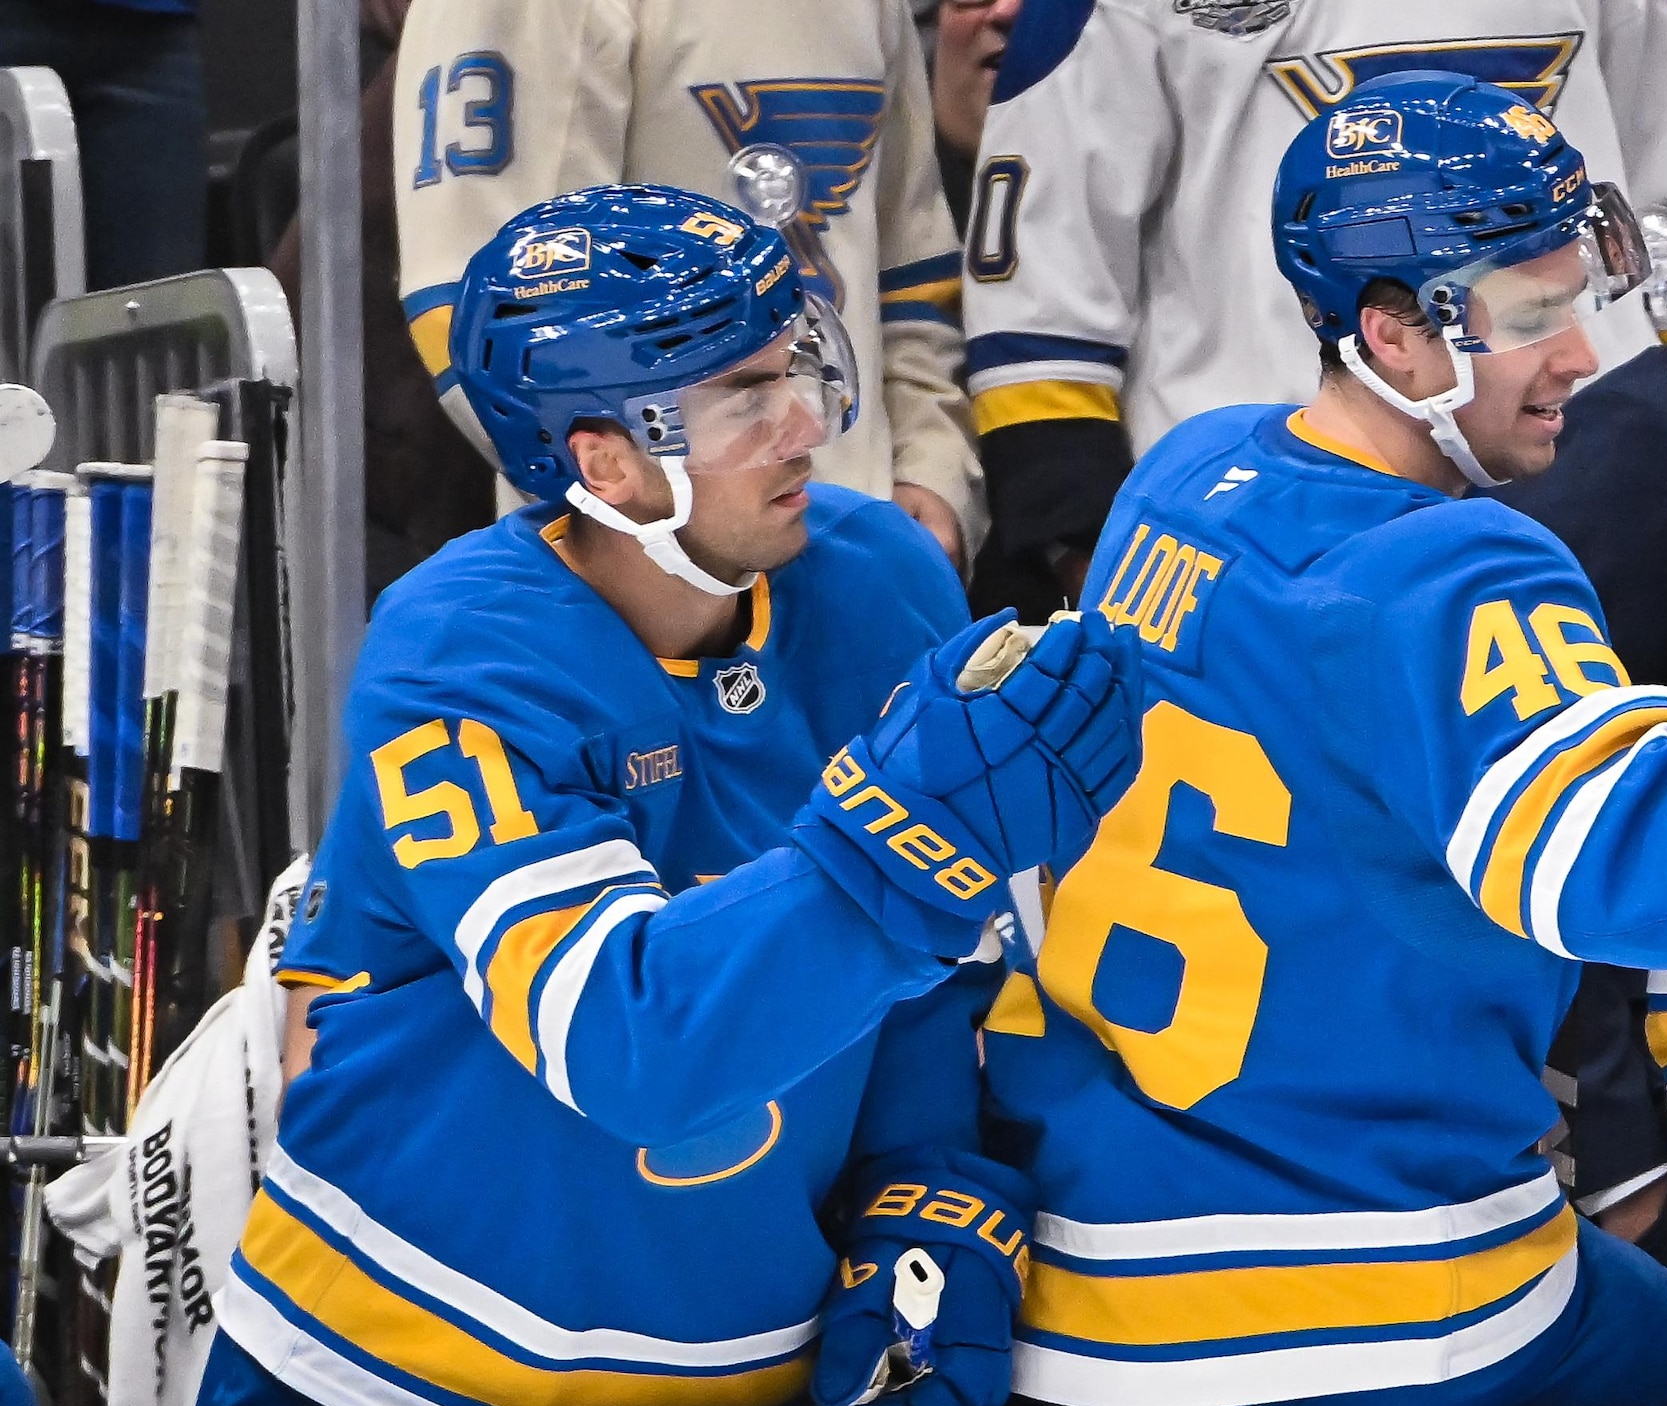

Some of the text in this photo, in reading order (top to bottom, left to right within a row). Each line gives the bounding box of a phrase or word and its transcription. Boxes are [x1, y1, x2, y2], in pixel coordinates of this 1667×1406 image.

[413, 51, 517, 189] 13
[1325, 160, 1401, 179] HealthCare
[513, 278, 591, 300] HealthCare
[1099, 523, 1224, 653] LOOF
[1460, 599, 1632, 722] 46
[370, 717, 540, 870] 51
[821, 745, 999, 900] BAUE
[984, 698, 1292, 1110] 6
[863, 1182, 1031, 1299] BAU
